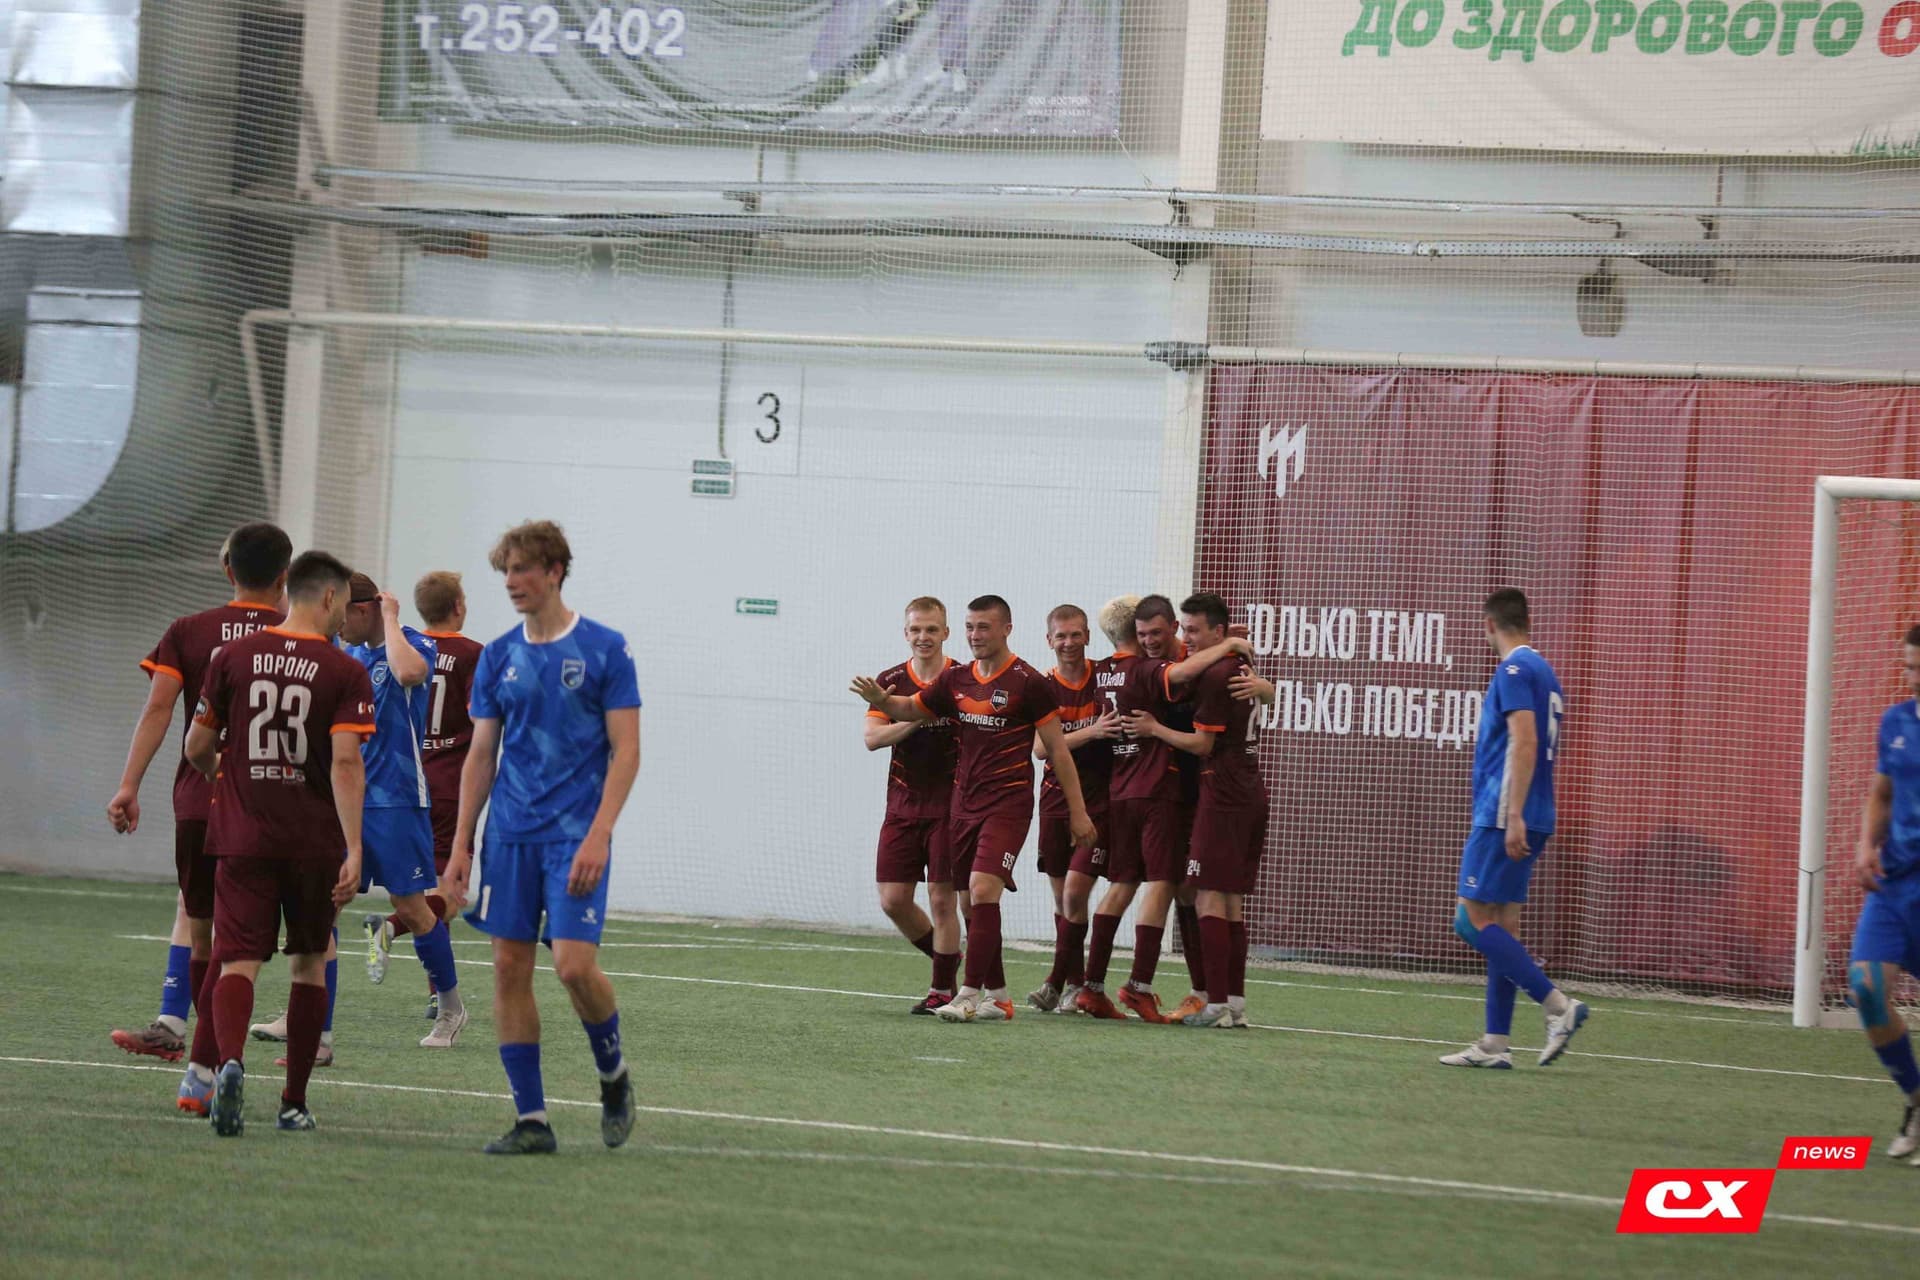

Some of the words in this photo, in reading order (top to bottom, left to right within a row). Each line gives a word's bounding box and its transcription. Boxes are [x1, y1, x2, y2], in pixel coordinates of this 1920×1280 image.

[1341, 0, 1445, 57] ДО
[1452, 0, 1864, 62] ЗДОРОВОГО
[755, 392, 780, 443] 3
[253, 653, 319, 682] ВОРОНА
[1367, 609, 1453, 671] ТЕМП,
[248, 679, 312, 764] 23
[1262, 679, 1354, 736] ЛЬКО
